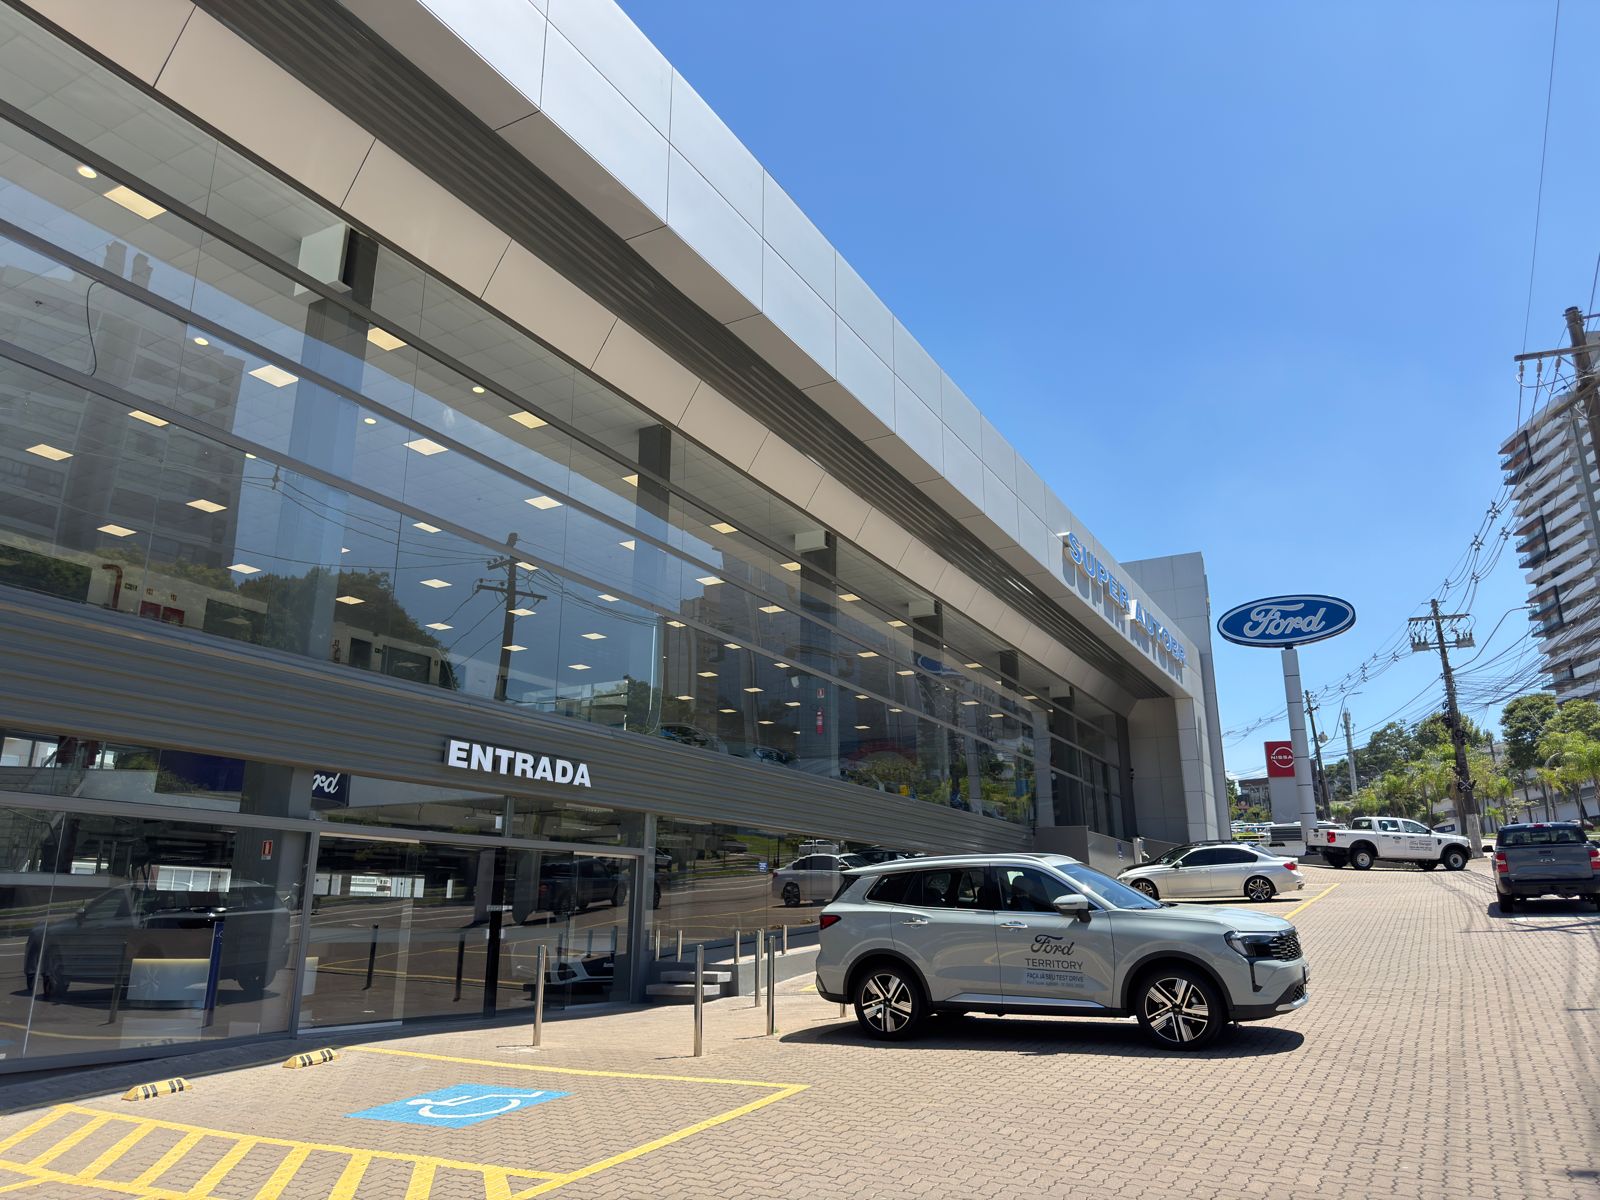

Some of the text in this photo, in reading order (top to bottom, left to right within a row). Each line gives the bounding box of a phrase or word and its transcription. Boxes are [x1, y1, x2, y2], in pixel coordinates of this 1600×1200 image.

[1067, 532, 1131, 614] SUPER
[1243, 603, 1327, 637] Ford
[447, 739, 592, 788] ENTRADA
[312, 772, 341, 794] rd
[1031, 934, 1075, 956] Ford
[1025, 958, 1084, 970] TERRITORY
[1056, 974, 1068, 982] TEST
[1069, 975, 1084, 983] DRIVE
